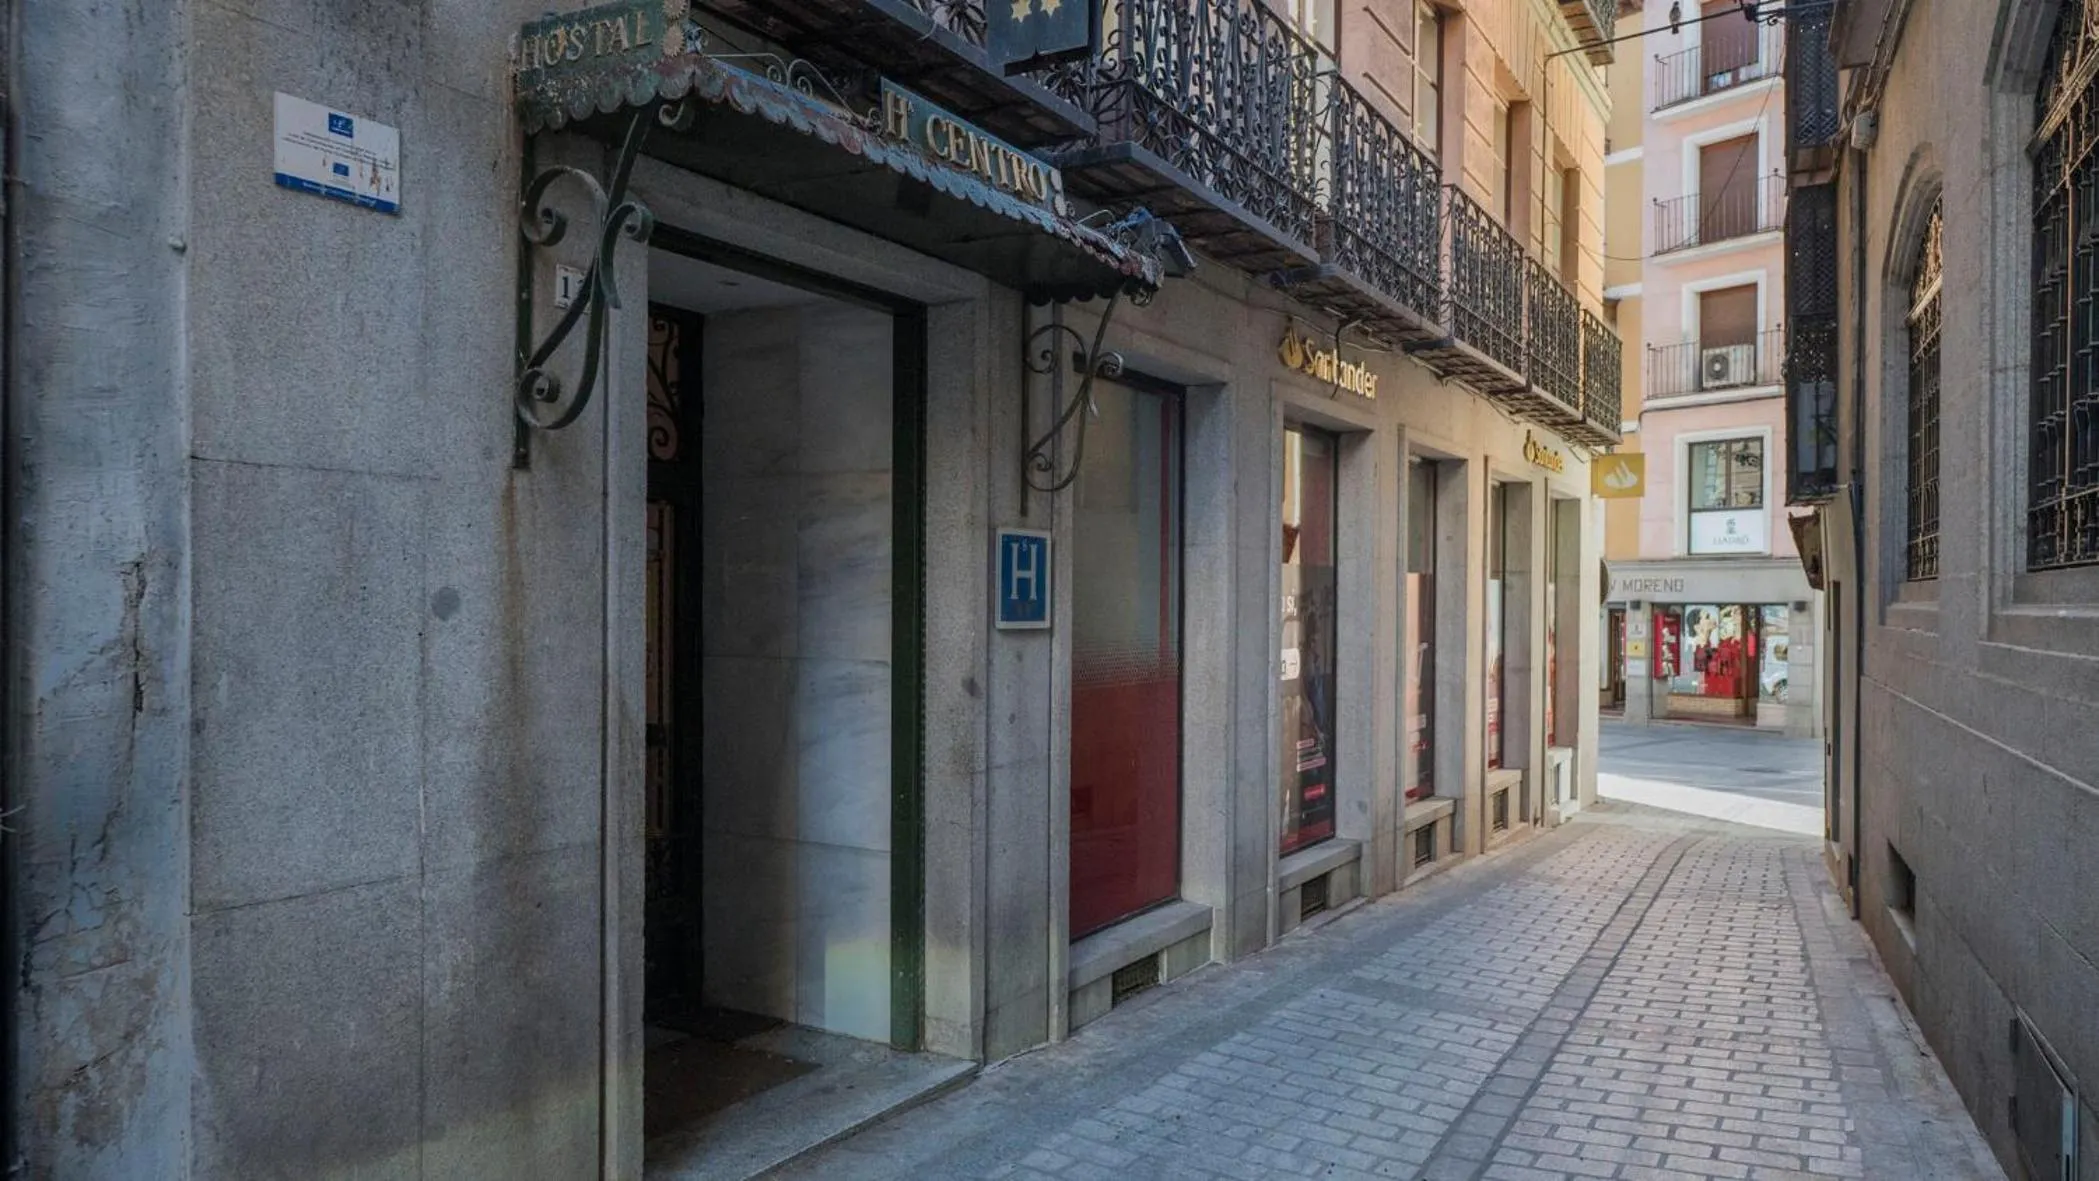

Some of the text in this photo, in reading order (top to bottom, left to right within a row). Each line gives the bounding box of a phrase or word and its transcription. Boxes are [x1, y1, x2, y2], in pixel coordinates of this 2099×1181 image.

[519, 11, 652, 71] HOSTAL
[926, 114, 1047, 200] CENTRO
[1305, 338, 1379, 399] Santander
[1622, 577, 1685, 593] MORENO
